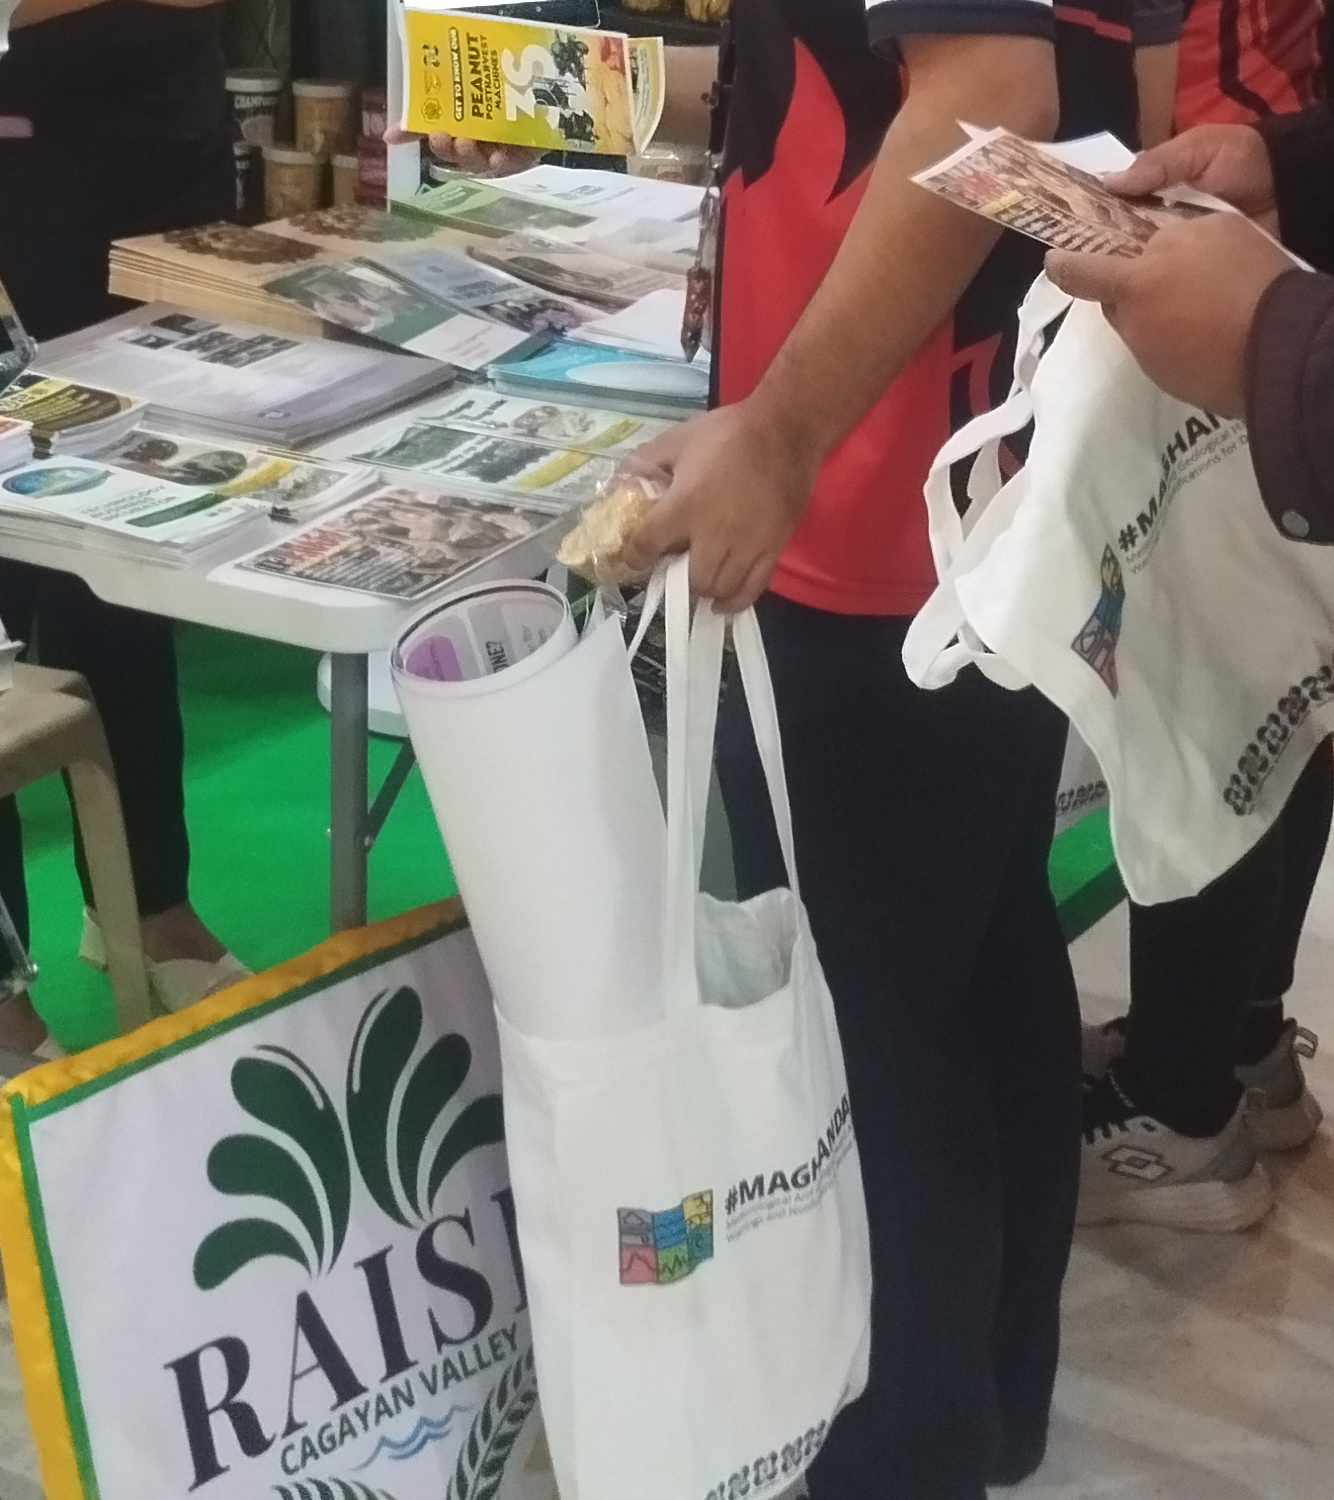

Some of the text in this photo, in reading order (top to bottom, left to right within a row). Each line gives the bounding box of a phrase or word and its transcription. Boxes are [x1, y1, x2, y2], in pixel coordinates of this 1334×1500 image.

[465, 31, 485, 119] PEANUT
[279, 1320, 519, 1477] CAGAYAN VALLEY
